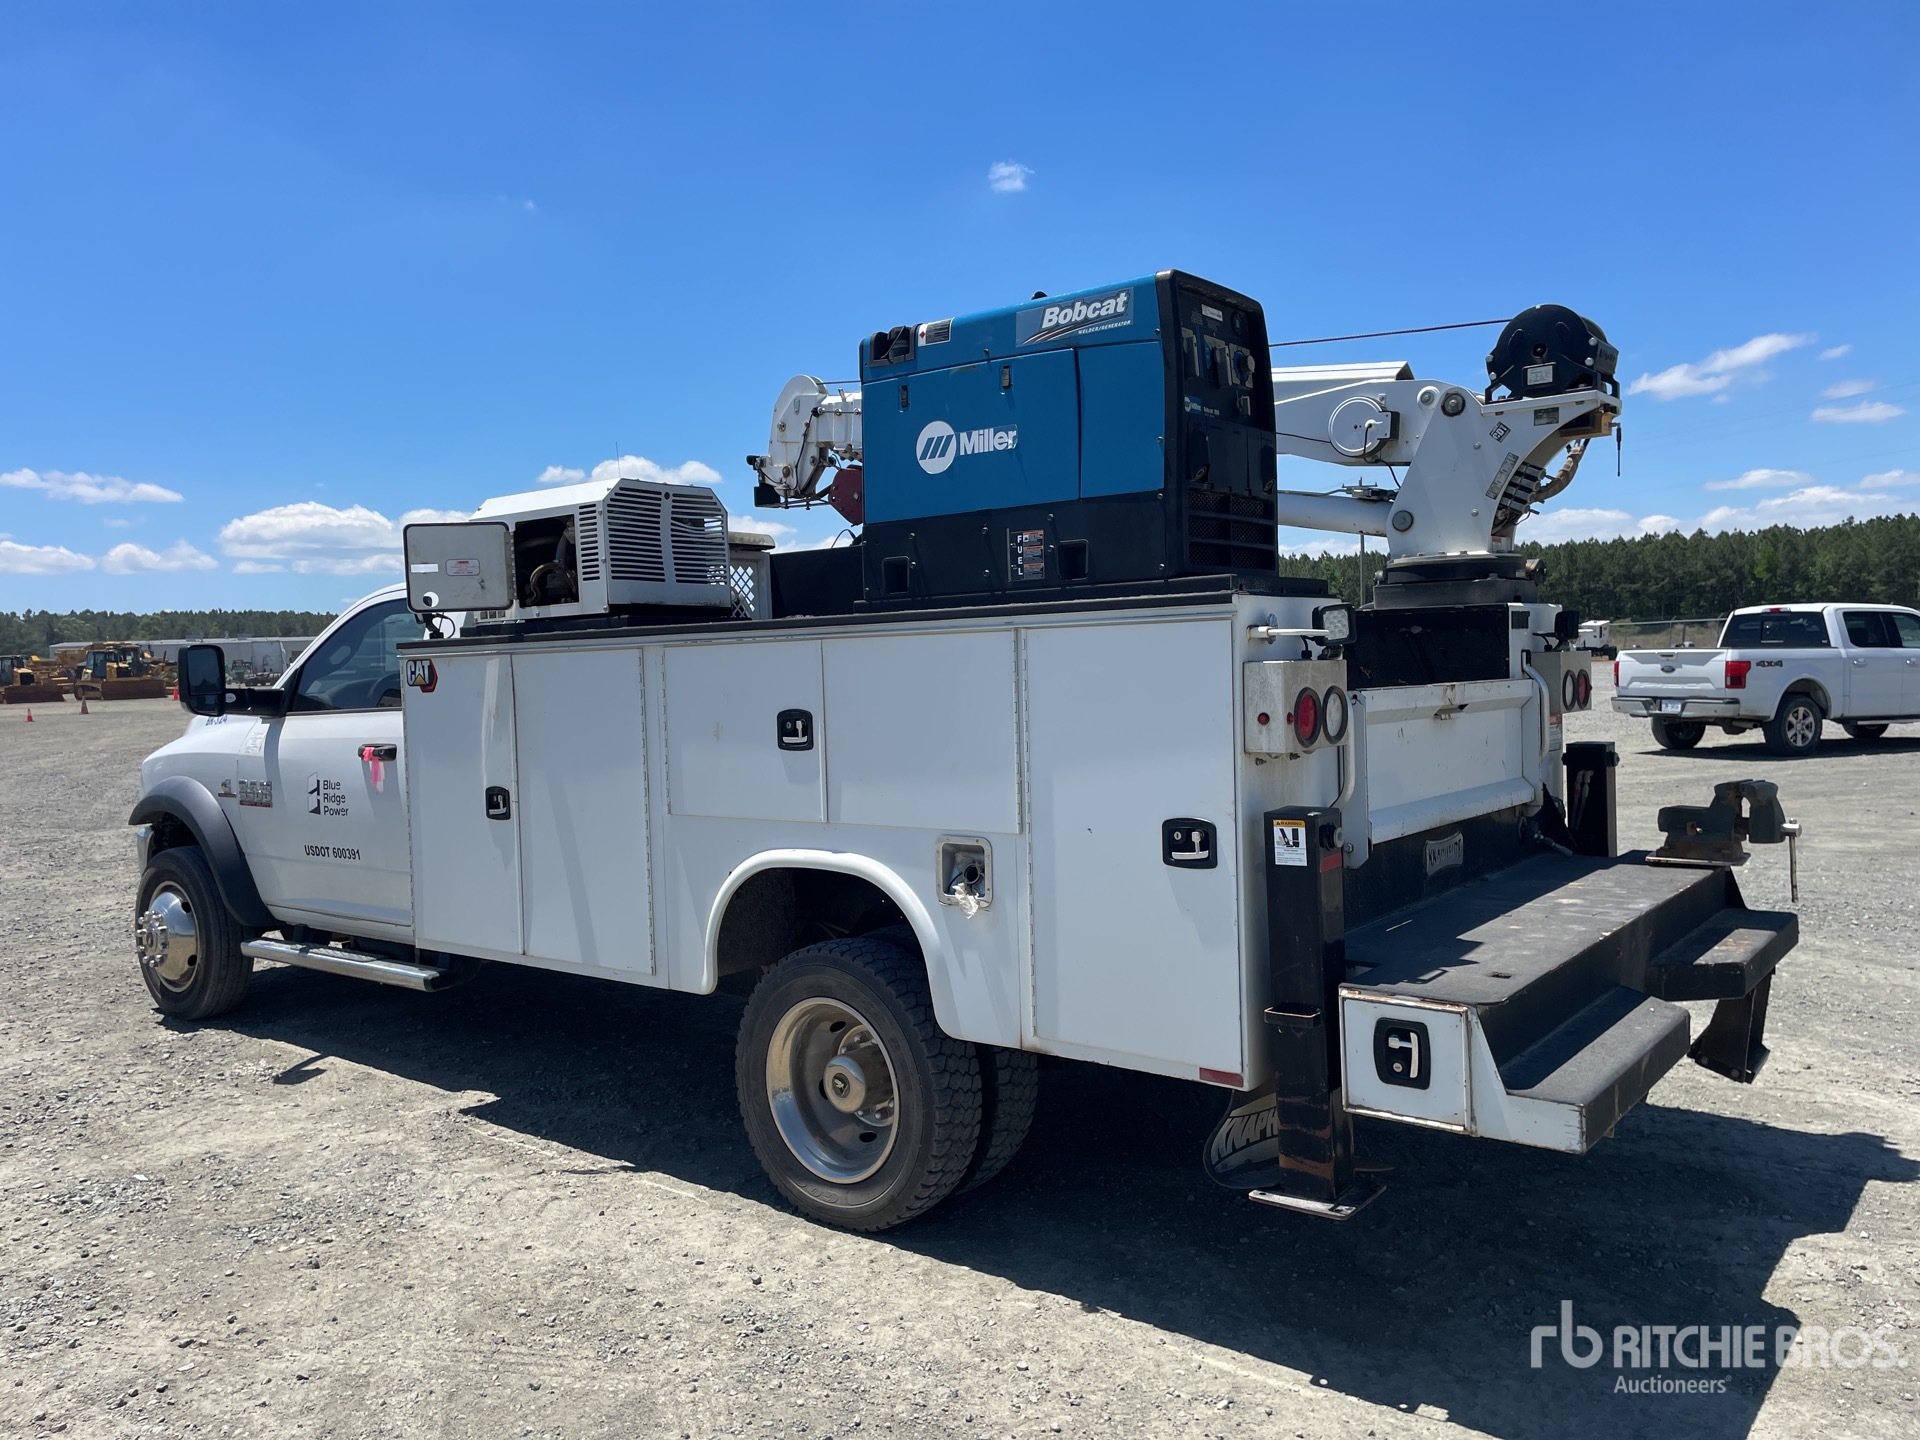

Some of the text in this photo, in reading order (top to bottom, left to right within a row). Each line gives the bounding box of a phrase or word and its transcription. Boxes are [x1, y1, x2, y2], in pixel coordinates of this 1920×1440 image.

[1041, 292, 1128, 329] Bobcat
[1078, 320, 1131, 335] WELDER/GENERATOR
[959, 427, 1017, 456] Miller
[406, 659, 431, 686] CAT
[323, 780, 341, 791] Blue
[323, 793, 346, 806] Ridge
[323, 805, 349, 817] Power
[304, 844, 361, 861] USDOT 600391
